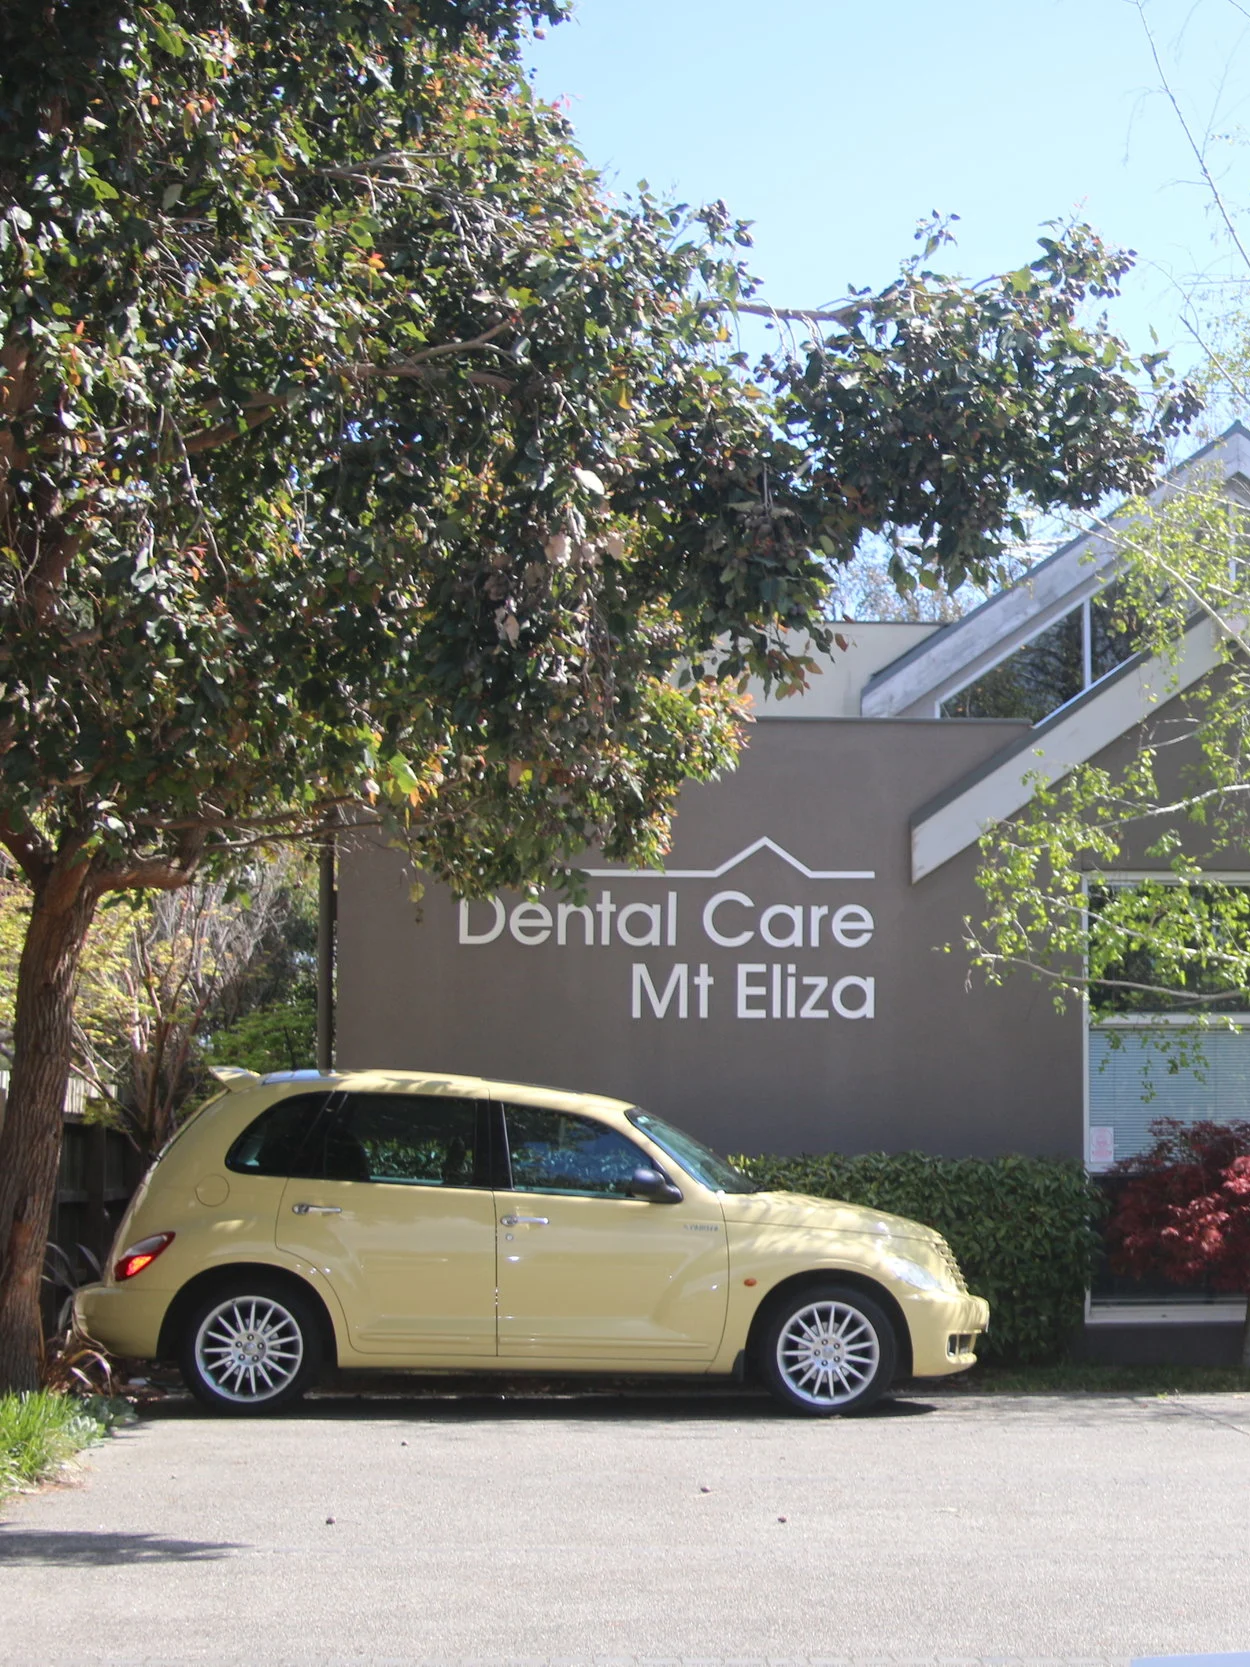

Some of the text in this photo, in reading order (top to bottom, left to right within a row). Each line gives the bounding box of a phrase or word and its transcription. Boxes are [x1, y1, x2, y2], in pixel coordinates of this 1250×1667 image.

[458, 891, 875, 948] Dental Care
[632, 963, 876, 1019] Mt Eliza
